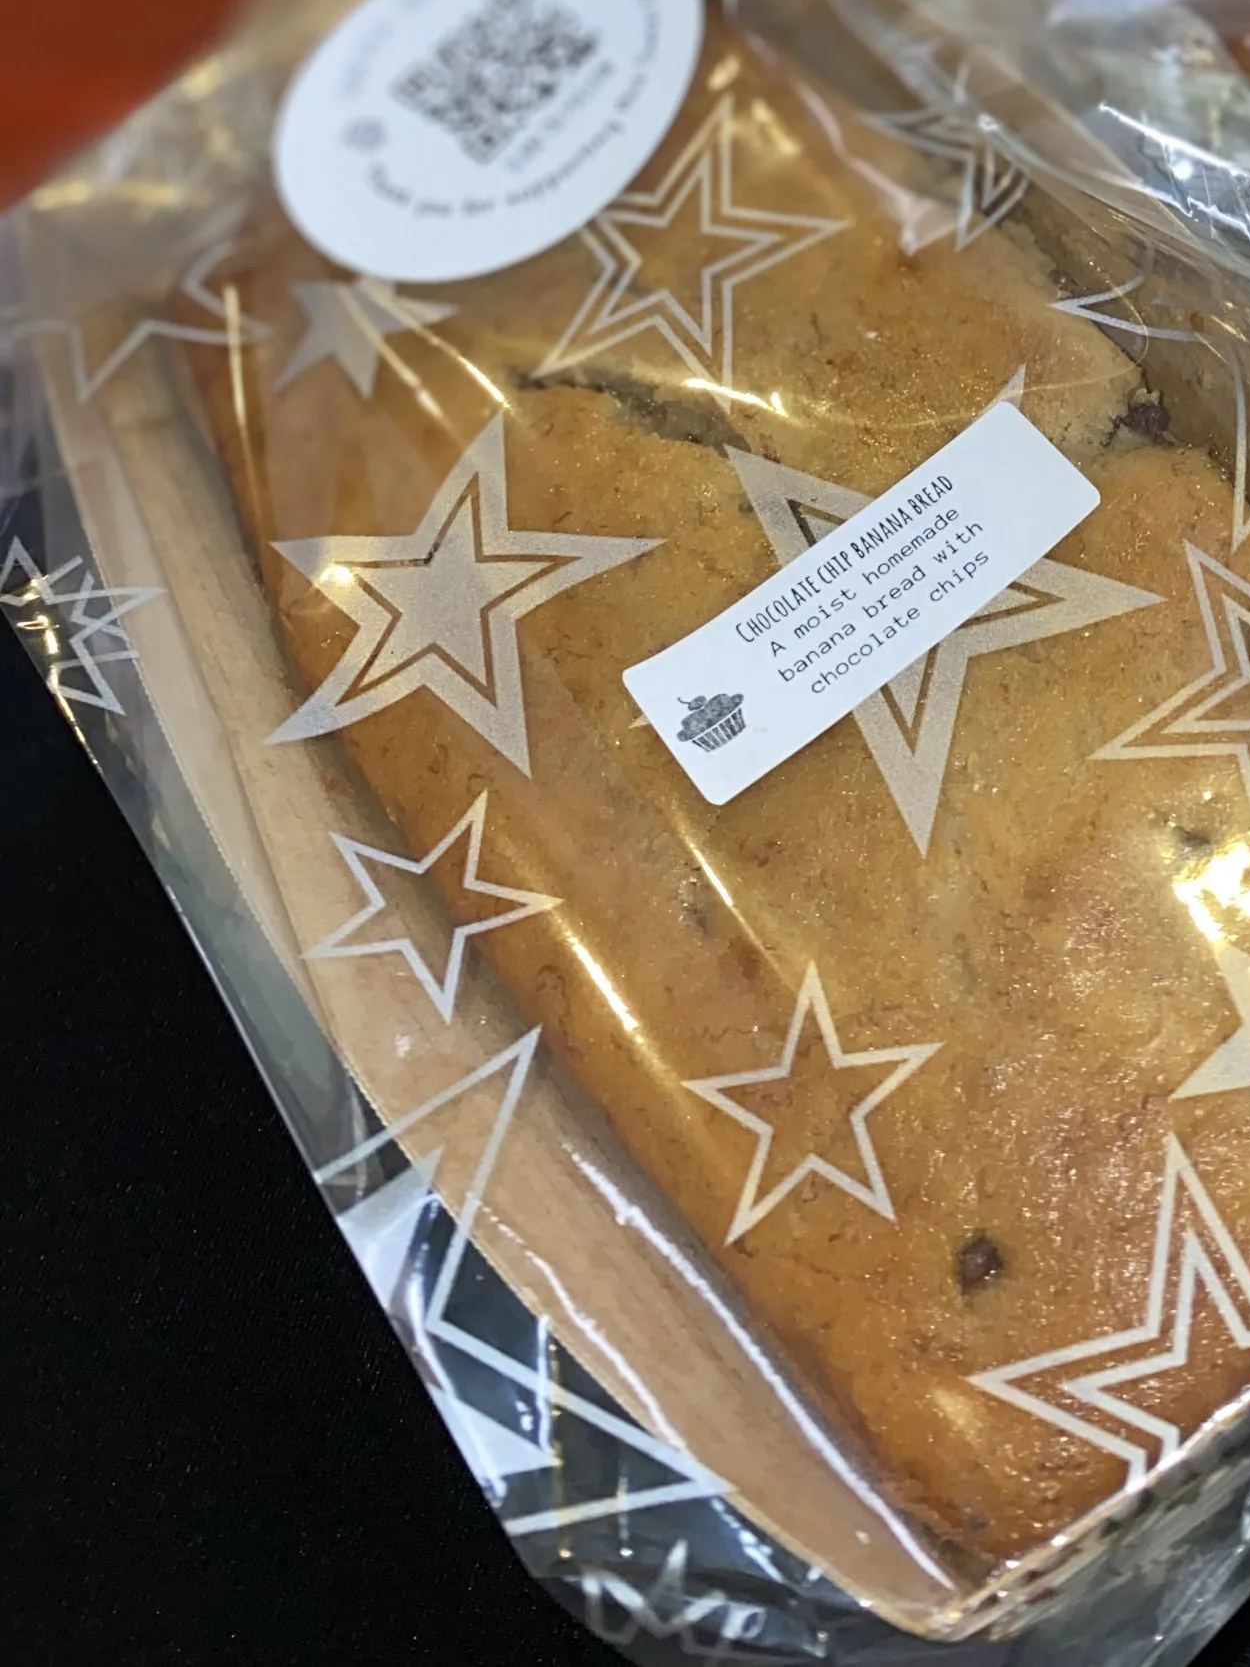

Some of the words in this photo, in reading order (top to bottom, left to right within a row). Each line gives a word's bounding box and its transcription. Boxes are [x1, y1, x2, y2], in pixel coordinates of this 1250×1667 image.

[735, 575, 821, 643] CHOCOLATE
[816, 550, 853, 585] CHIP
[850, 508, 914, 559] BANANA
[907, 475, 953, 516] BREAD
[770, 640, 787, 658] A
[793, 589, 857, 639] moist
[861, 509, 959, 586] homemade
[777, 623, 857, 683] banana
[861, 564, 927, 619] bread
[932, 523, 984, 564] with
[811, 607, 921, 694] chocolate
[929, 551, 989, 602] chips
